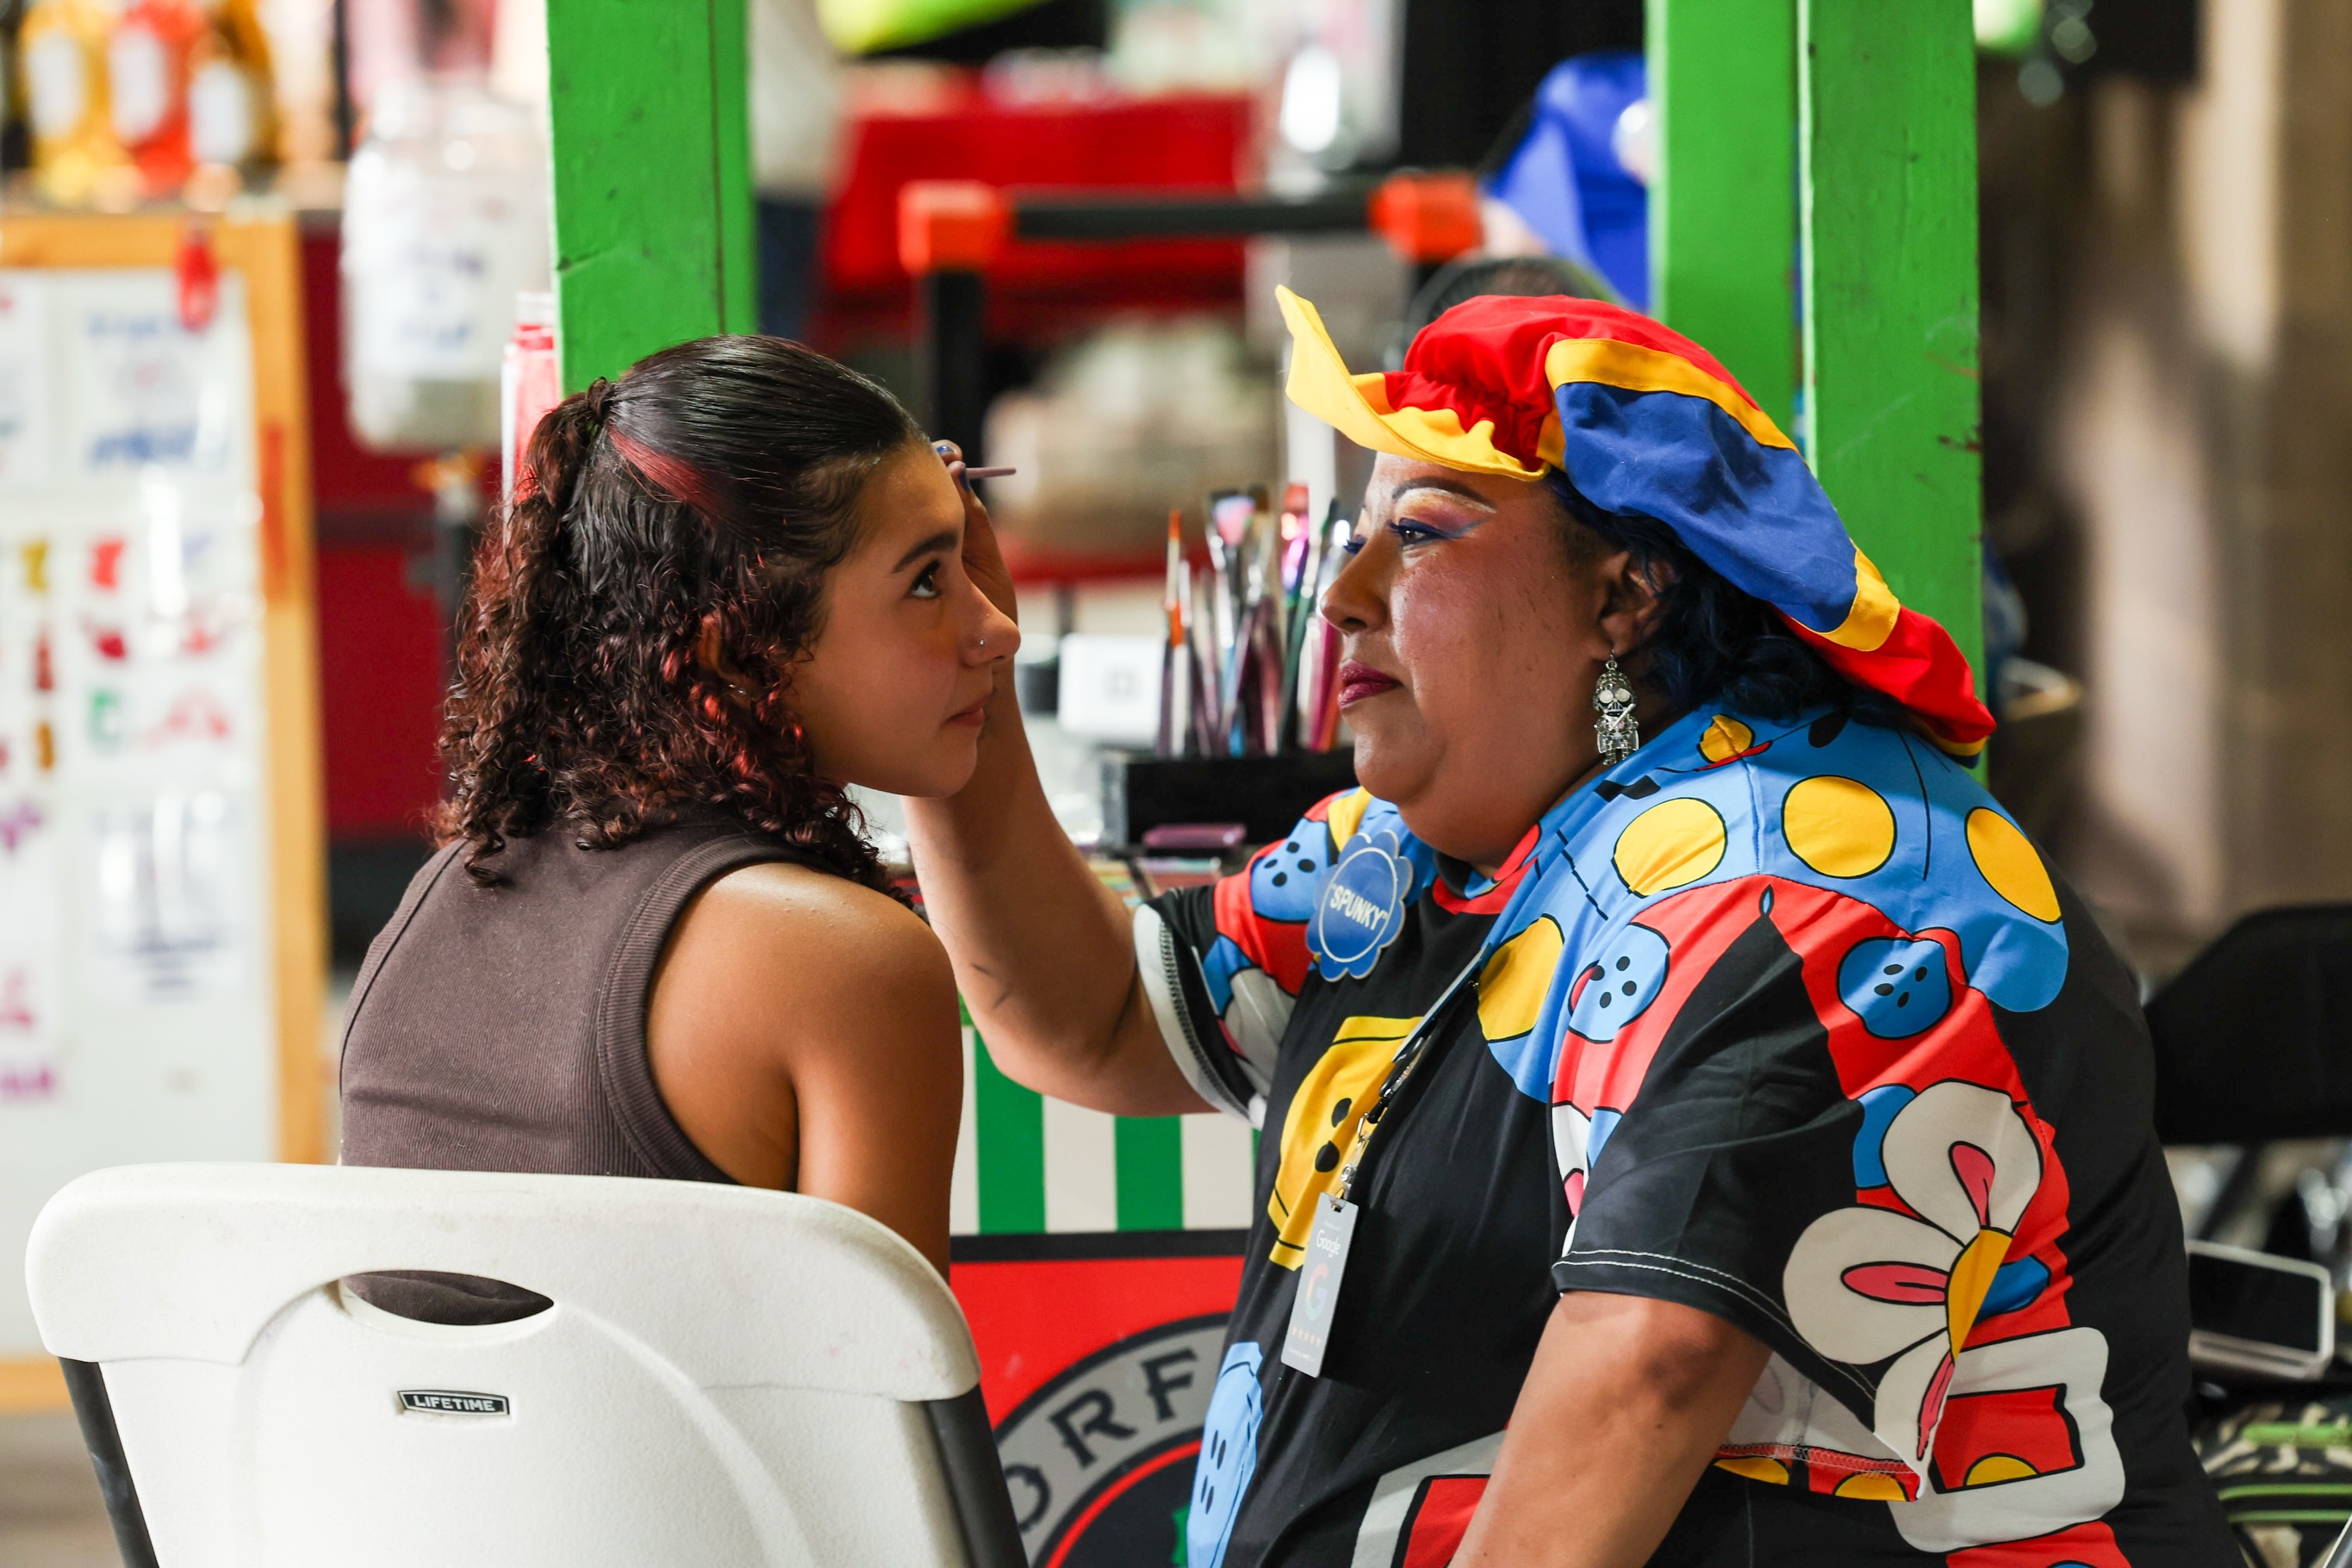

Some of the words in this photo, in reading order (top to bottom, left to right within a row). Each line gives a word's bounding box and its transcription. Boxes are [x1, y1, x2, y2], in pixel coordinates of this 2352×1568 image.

[1316, 1229, 1341, 1258] Google
[1305, 1261, 1329, 1322] G
[412, 1394, 496, 1412] LIFETIME
